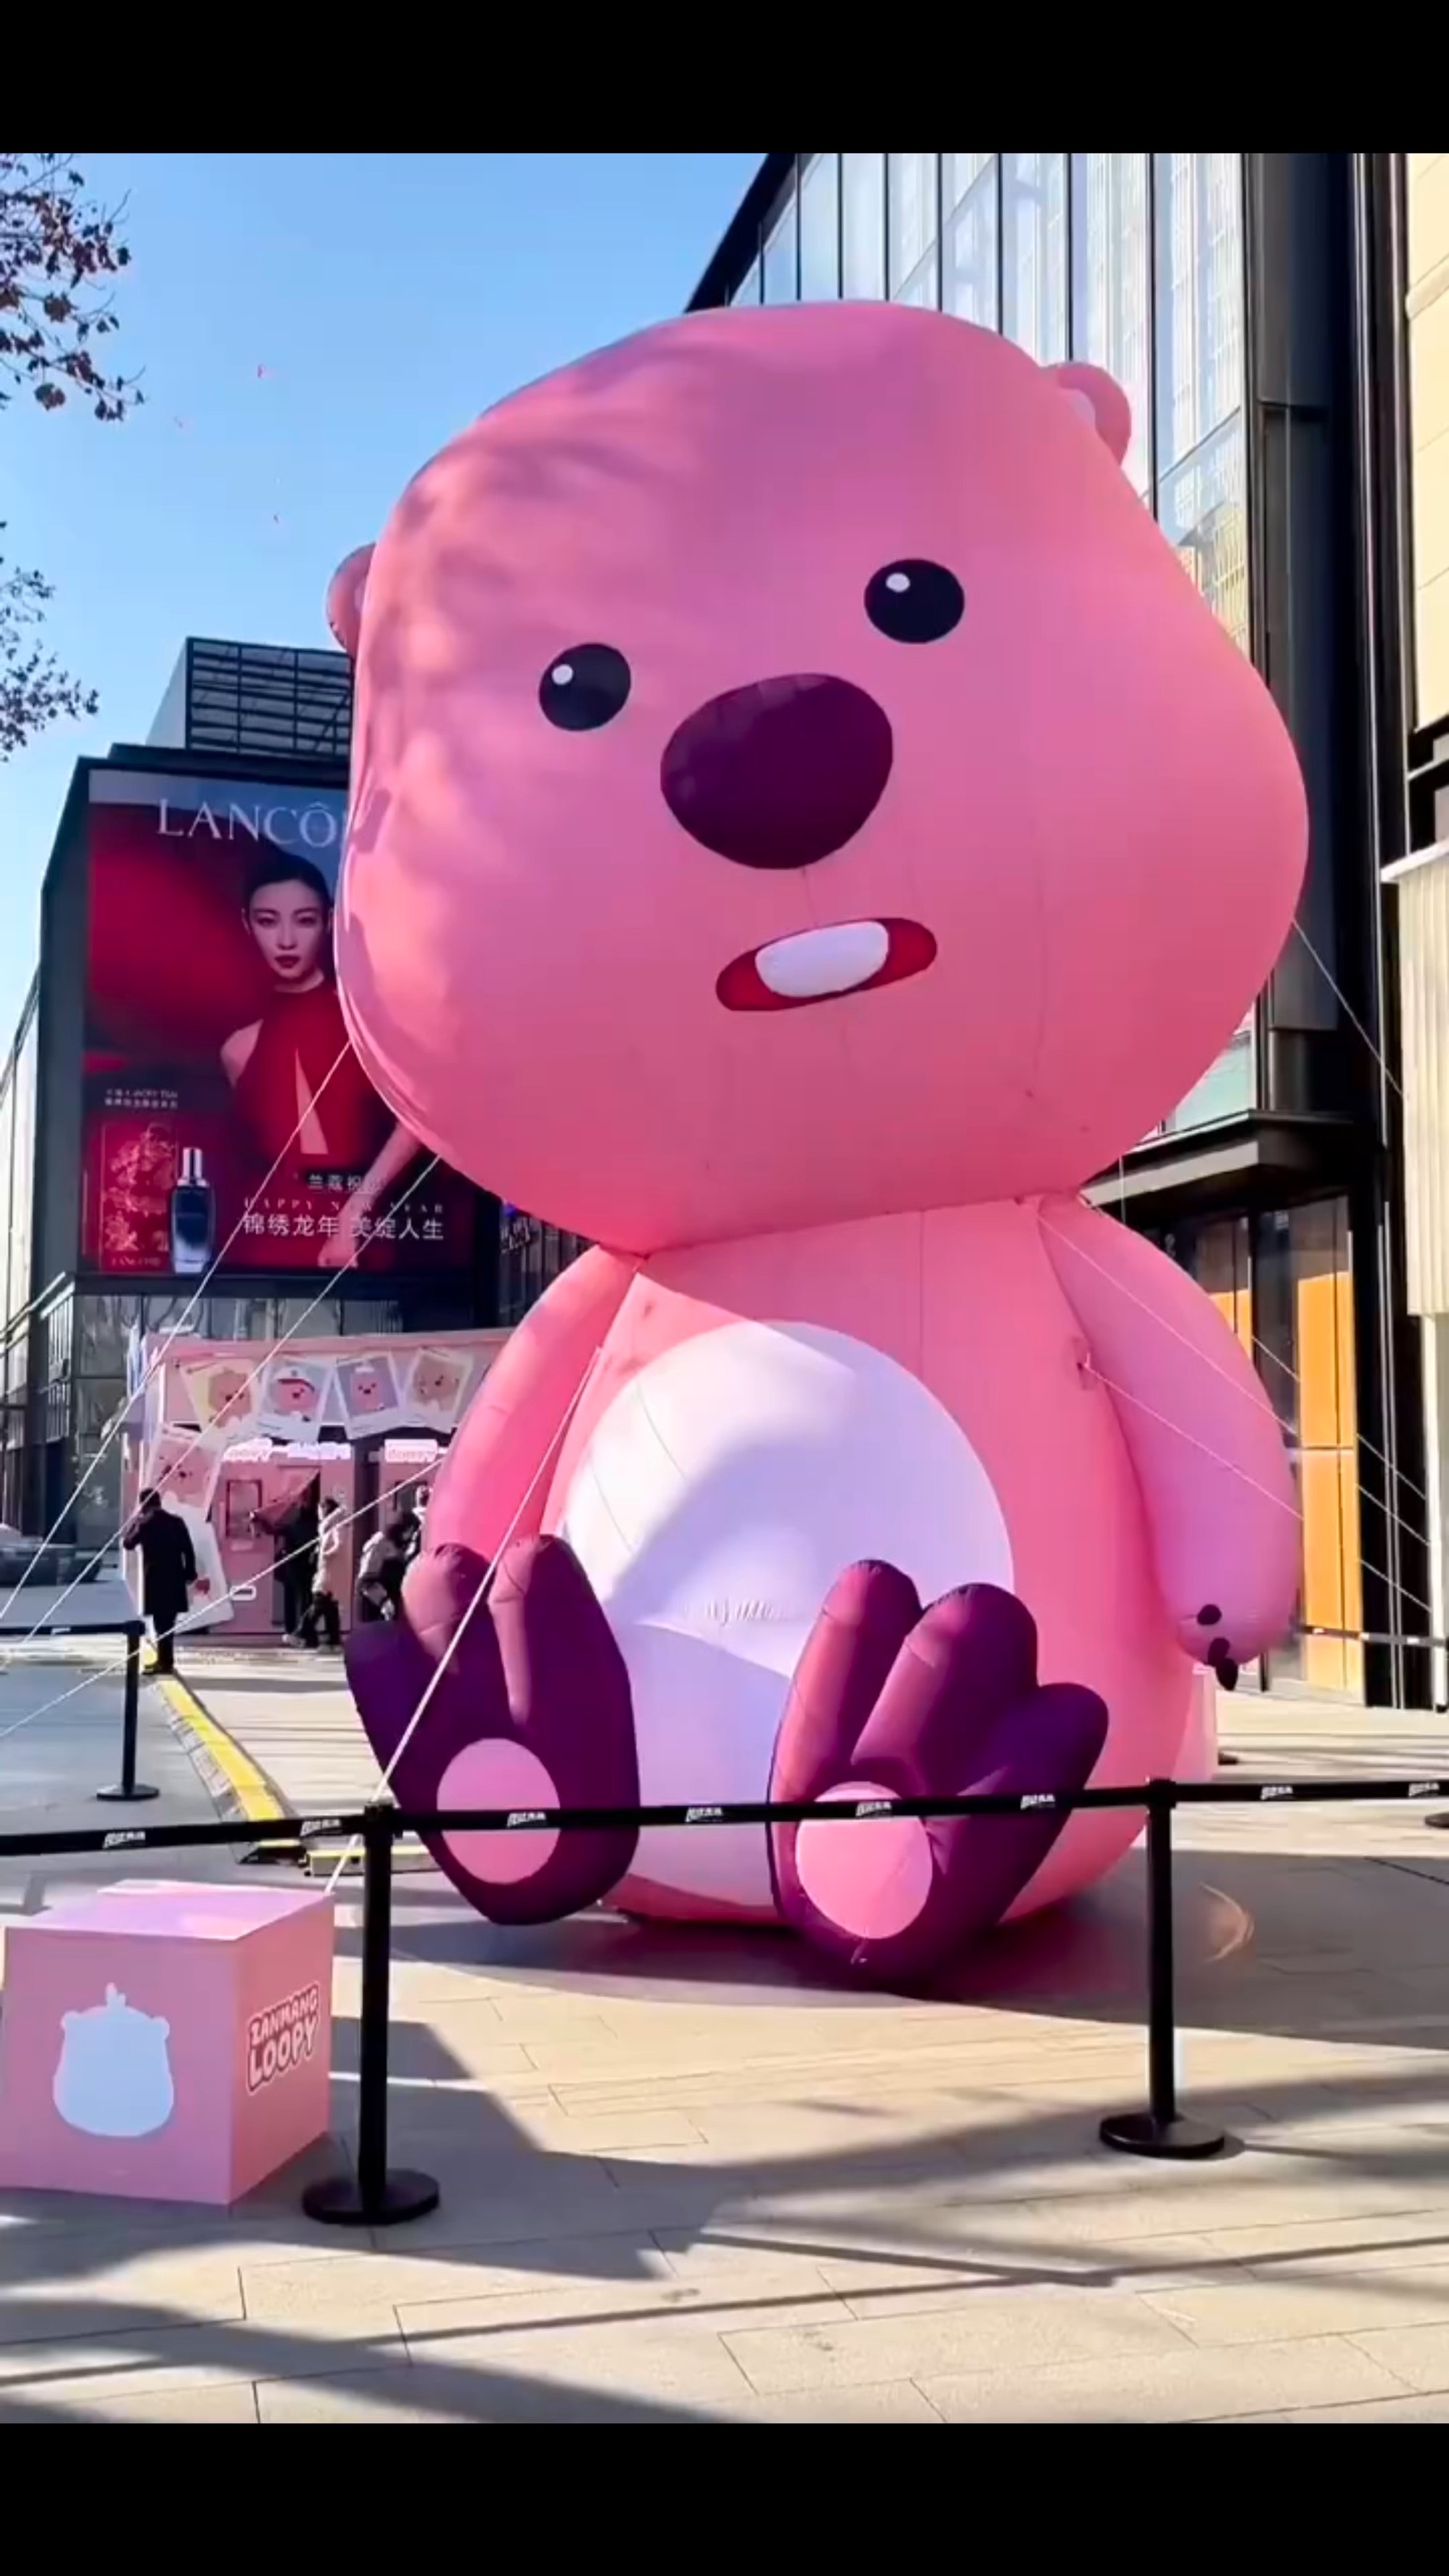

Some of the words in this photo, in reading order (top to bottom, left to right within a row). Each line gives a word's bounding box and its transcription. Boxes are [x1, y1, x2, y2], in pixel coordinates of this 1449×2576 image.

[157, 798, 345, 848] LANCÔ
[243, 1212, 340, 1238] 锦绣龙年
[249, 2014, 317, 2090] LOOPY
